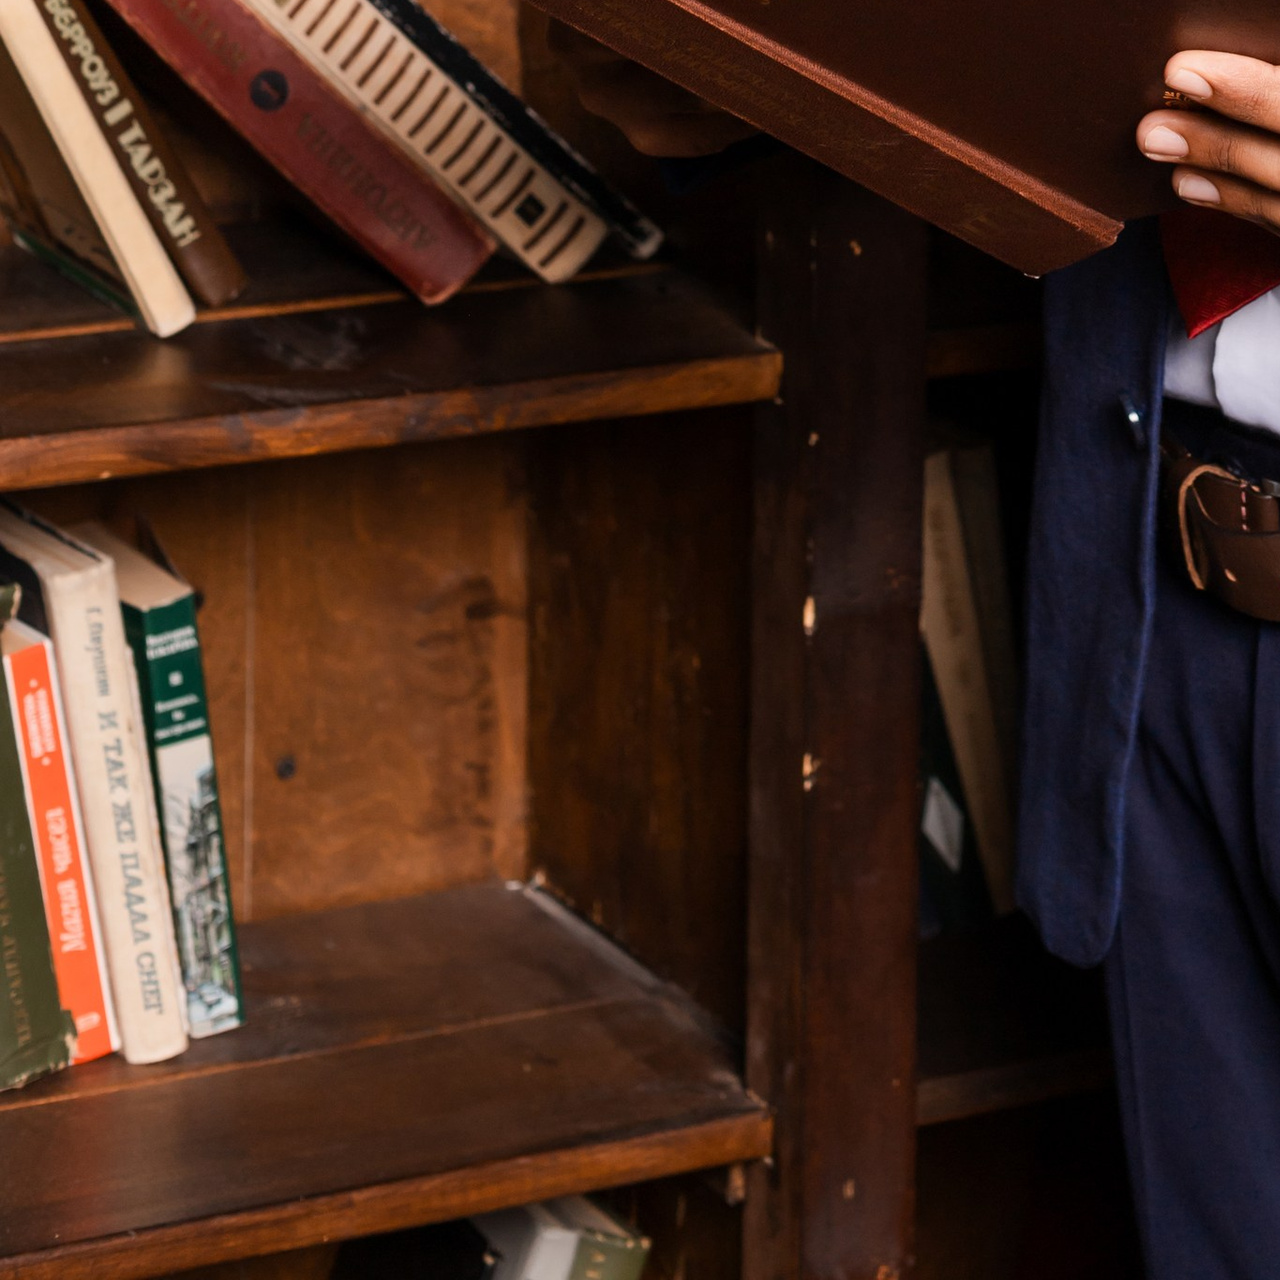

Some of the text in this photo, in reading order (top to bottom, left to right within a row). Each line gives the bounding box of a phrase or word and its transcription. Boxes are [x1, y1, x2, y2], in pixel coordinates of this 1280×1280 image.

[117, 118, 201, 248] ТАРЗАН
[102, 737, 129, 795] ТАК
[112, 797, 137, 845] ЖЕ
[119, 851, 151, 946] ПАДАЛ
[134, 951, 165, 1016] СНЕГ
